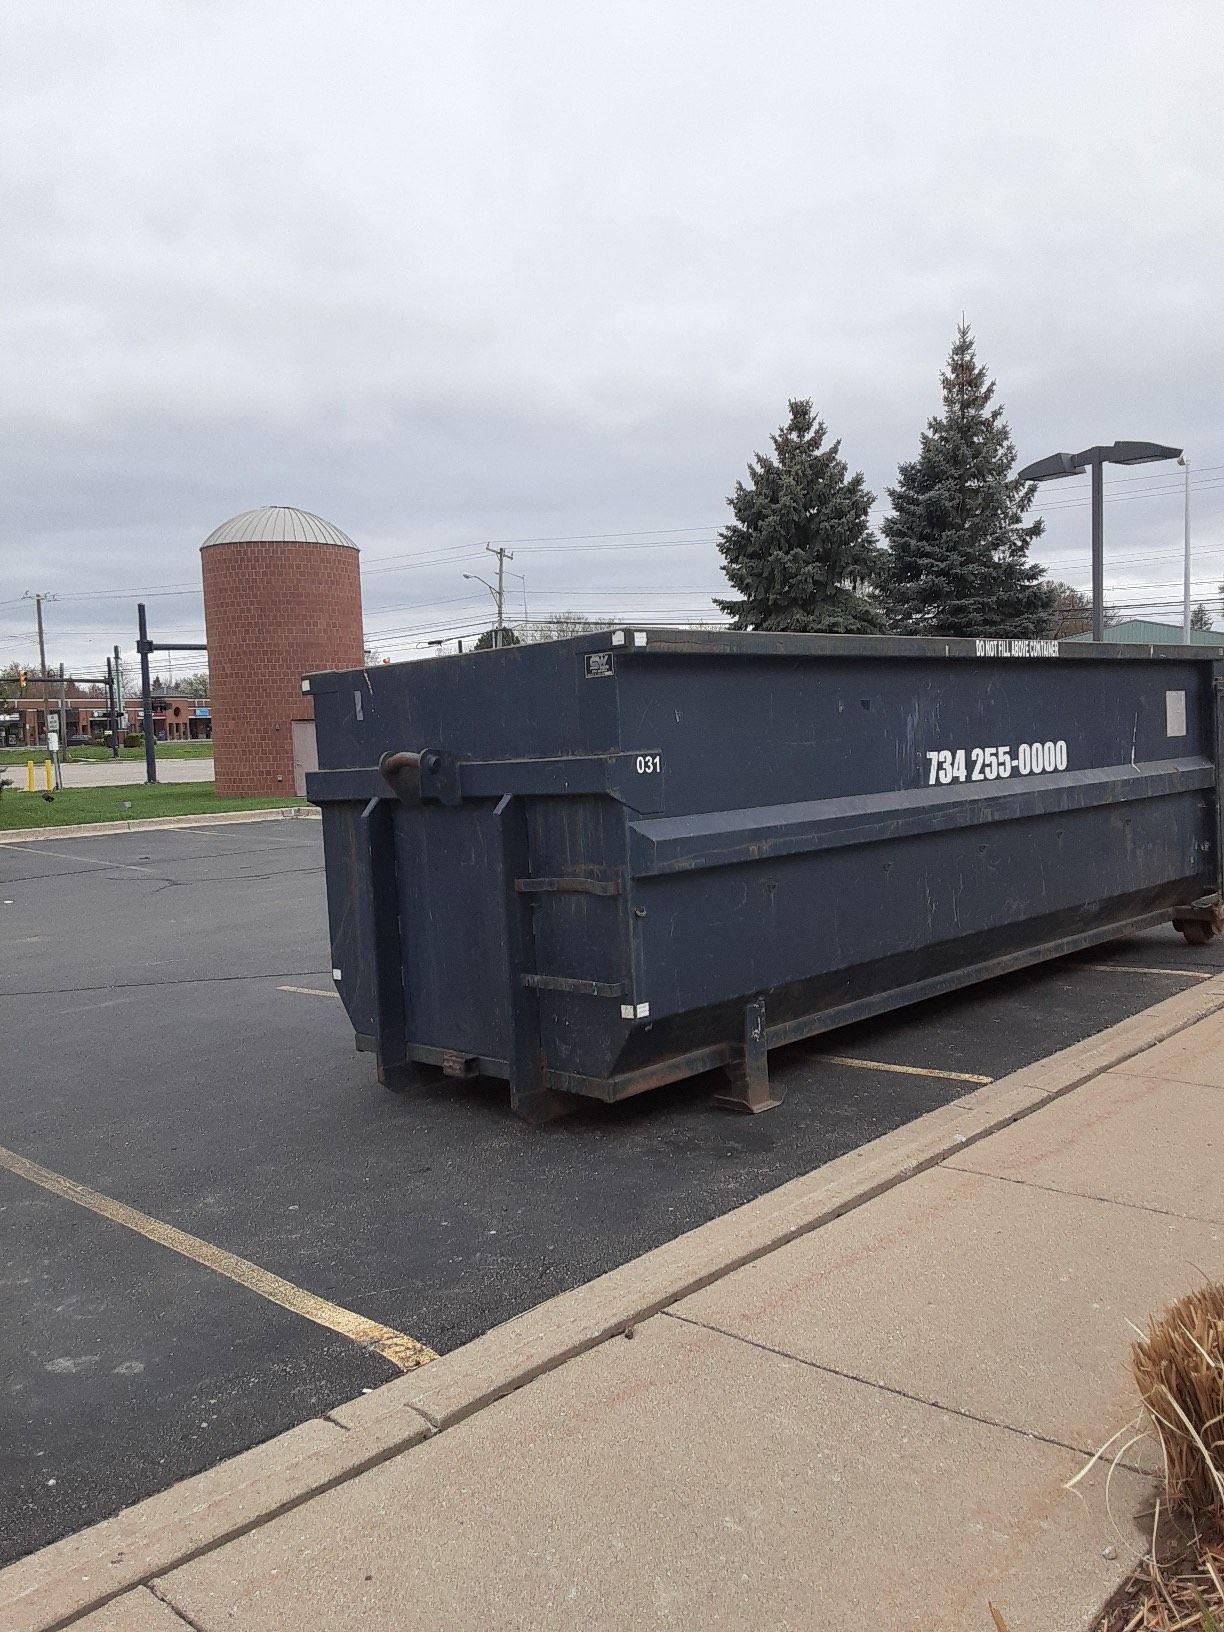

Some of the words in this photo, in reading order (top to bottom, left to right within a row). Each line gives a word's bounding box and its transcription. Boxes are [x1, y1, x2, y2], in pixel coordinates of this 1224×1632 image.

[976, 640, 985, 656] DO
[986, 640, 997, 657] NOT
[998, 640, 1011, 657] FILL
[1011, 640, 1029, 657] ABOVE
[1029, 640, 1059, 657] CONTAINER
[636, 755, 661, 774] 031
[926, 749, 967, 785] 734
[971, 740, 1067, 781] 255-0000
